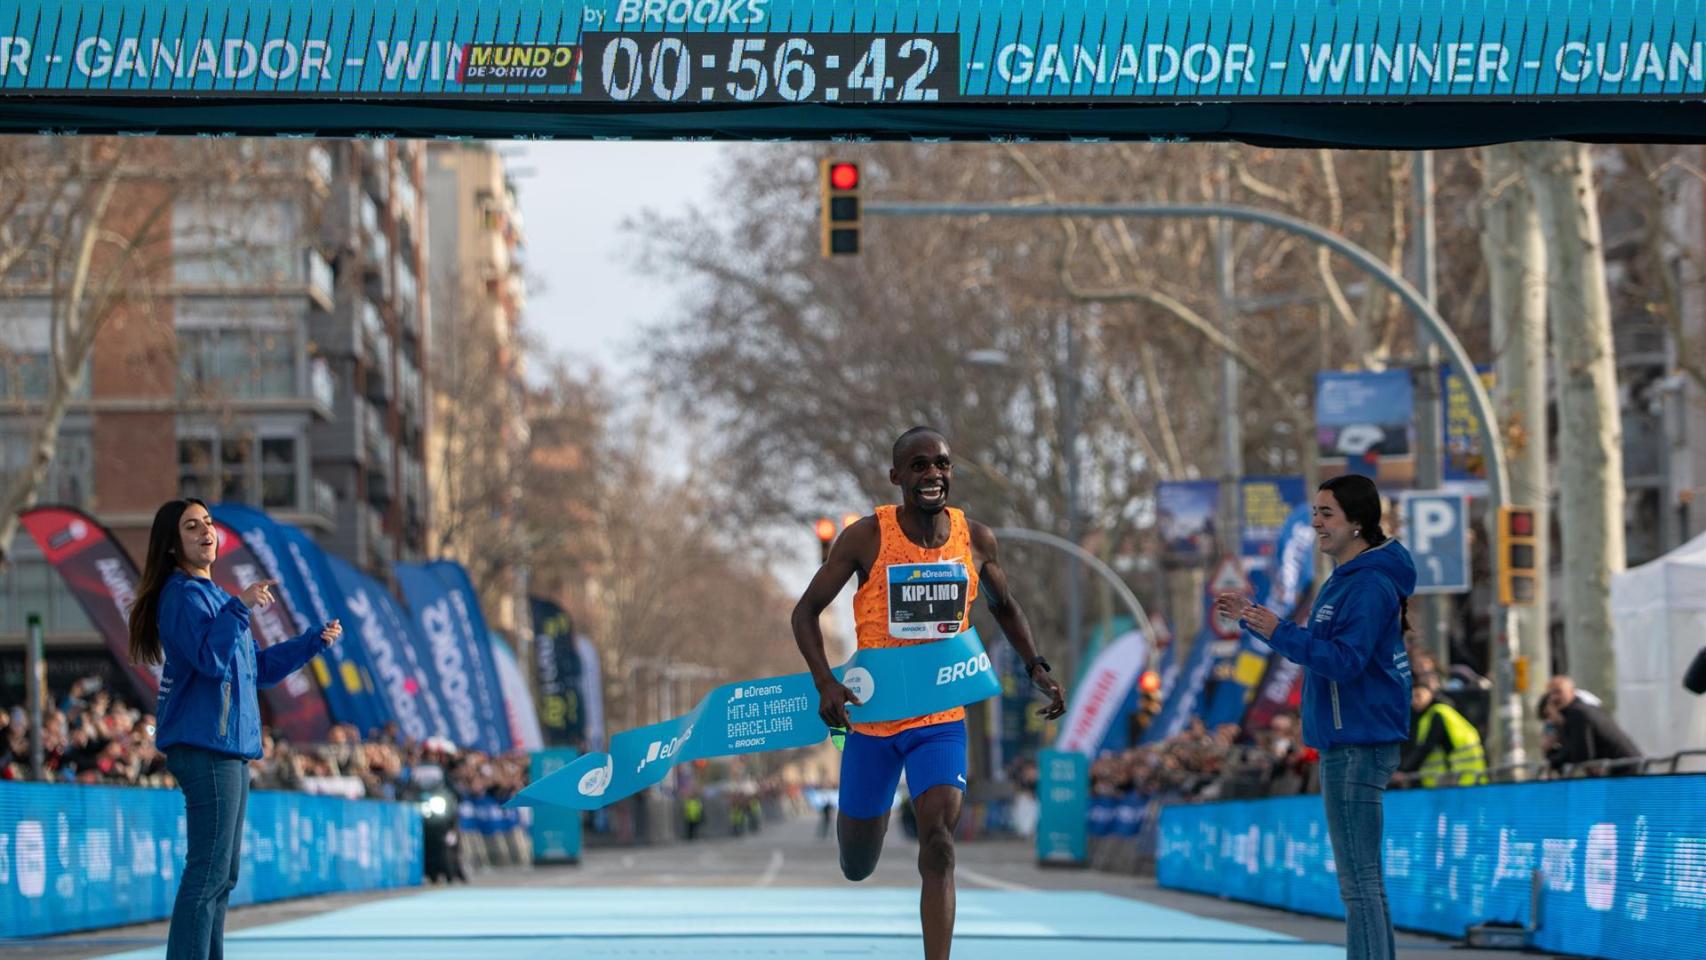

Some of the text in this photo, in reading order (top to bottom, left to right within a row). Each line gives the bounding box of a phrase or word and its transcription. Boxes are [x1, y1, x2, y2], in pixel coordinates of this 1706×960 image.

[584, 0, 768, 26] by BROOKS
[76, 37, 333, 79] GANADOR
[376, 39, 465, 80] WIN
[469, 47, 572, 66] MUNDO
[997, 42, 1256, 85] GANADOR
[1300, 42, 1509, 83] WINNER
[1555, 41, 1706, 82] GUAN
[600, 37, 940, 102] 00:56:42
[1413, 499, 1456, 554] P
[921, 569, 953, 578] eDreams
[902, 584, 959, 602] KIPLIMO
[928, 603, 934, 614] 1
[936, 652, 991, 685] BROO
[744, 685, 783, 698] eDreams
[727, 693, 808, 720] MITJA MARATÓ
[727, 717, 793, 738] BARCELONA
[735, 737, 766, 749] BROOKS
